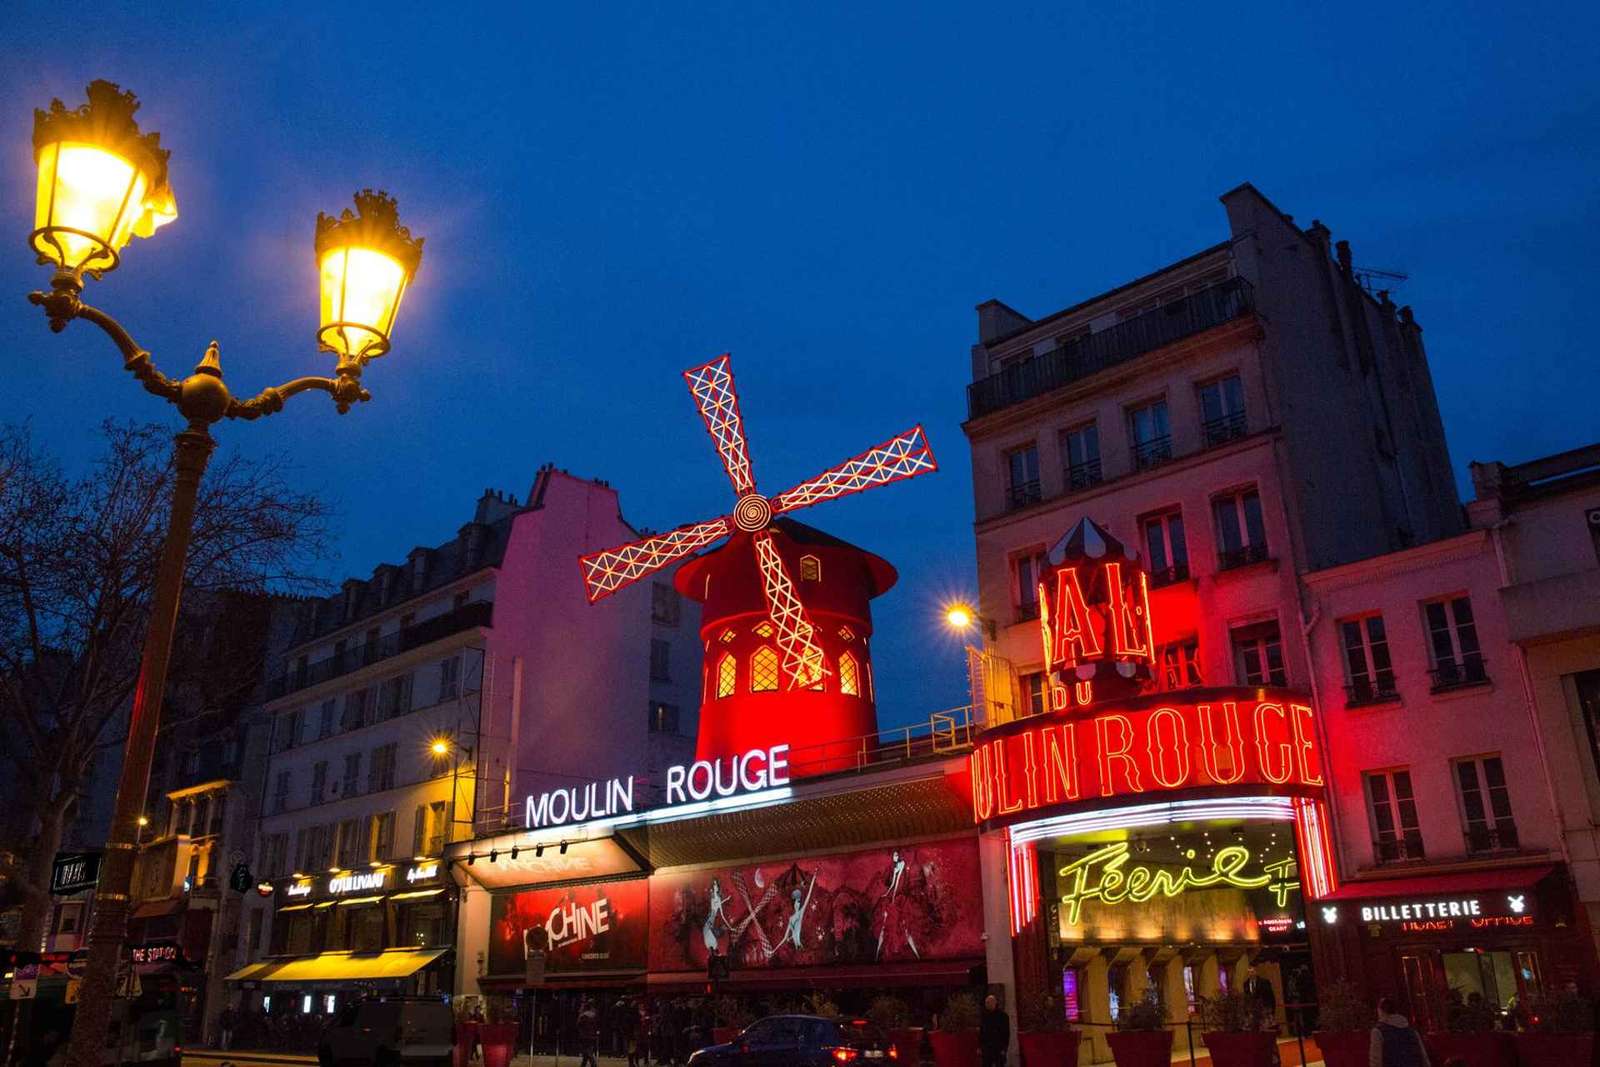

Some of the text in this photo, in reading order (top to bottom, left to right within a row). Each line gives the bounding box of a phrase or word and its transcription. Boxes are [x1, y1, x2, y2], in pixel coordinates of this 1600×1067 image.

[1052, 681, 1092, 710] DU
[1095, 702, 1324, 798] ROUGE
[525, 744, 790, 829] MOULIN ROUGE
[1361, 900, 1481, 921] BILLETTERIE
